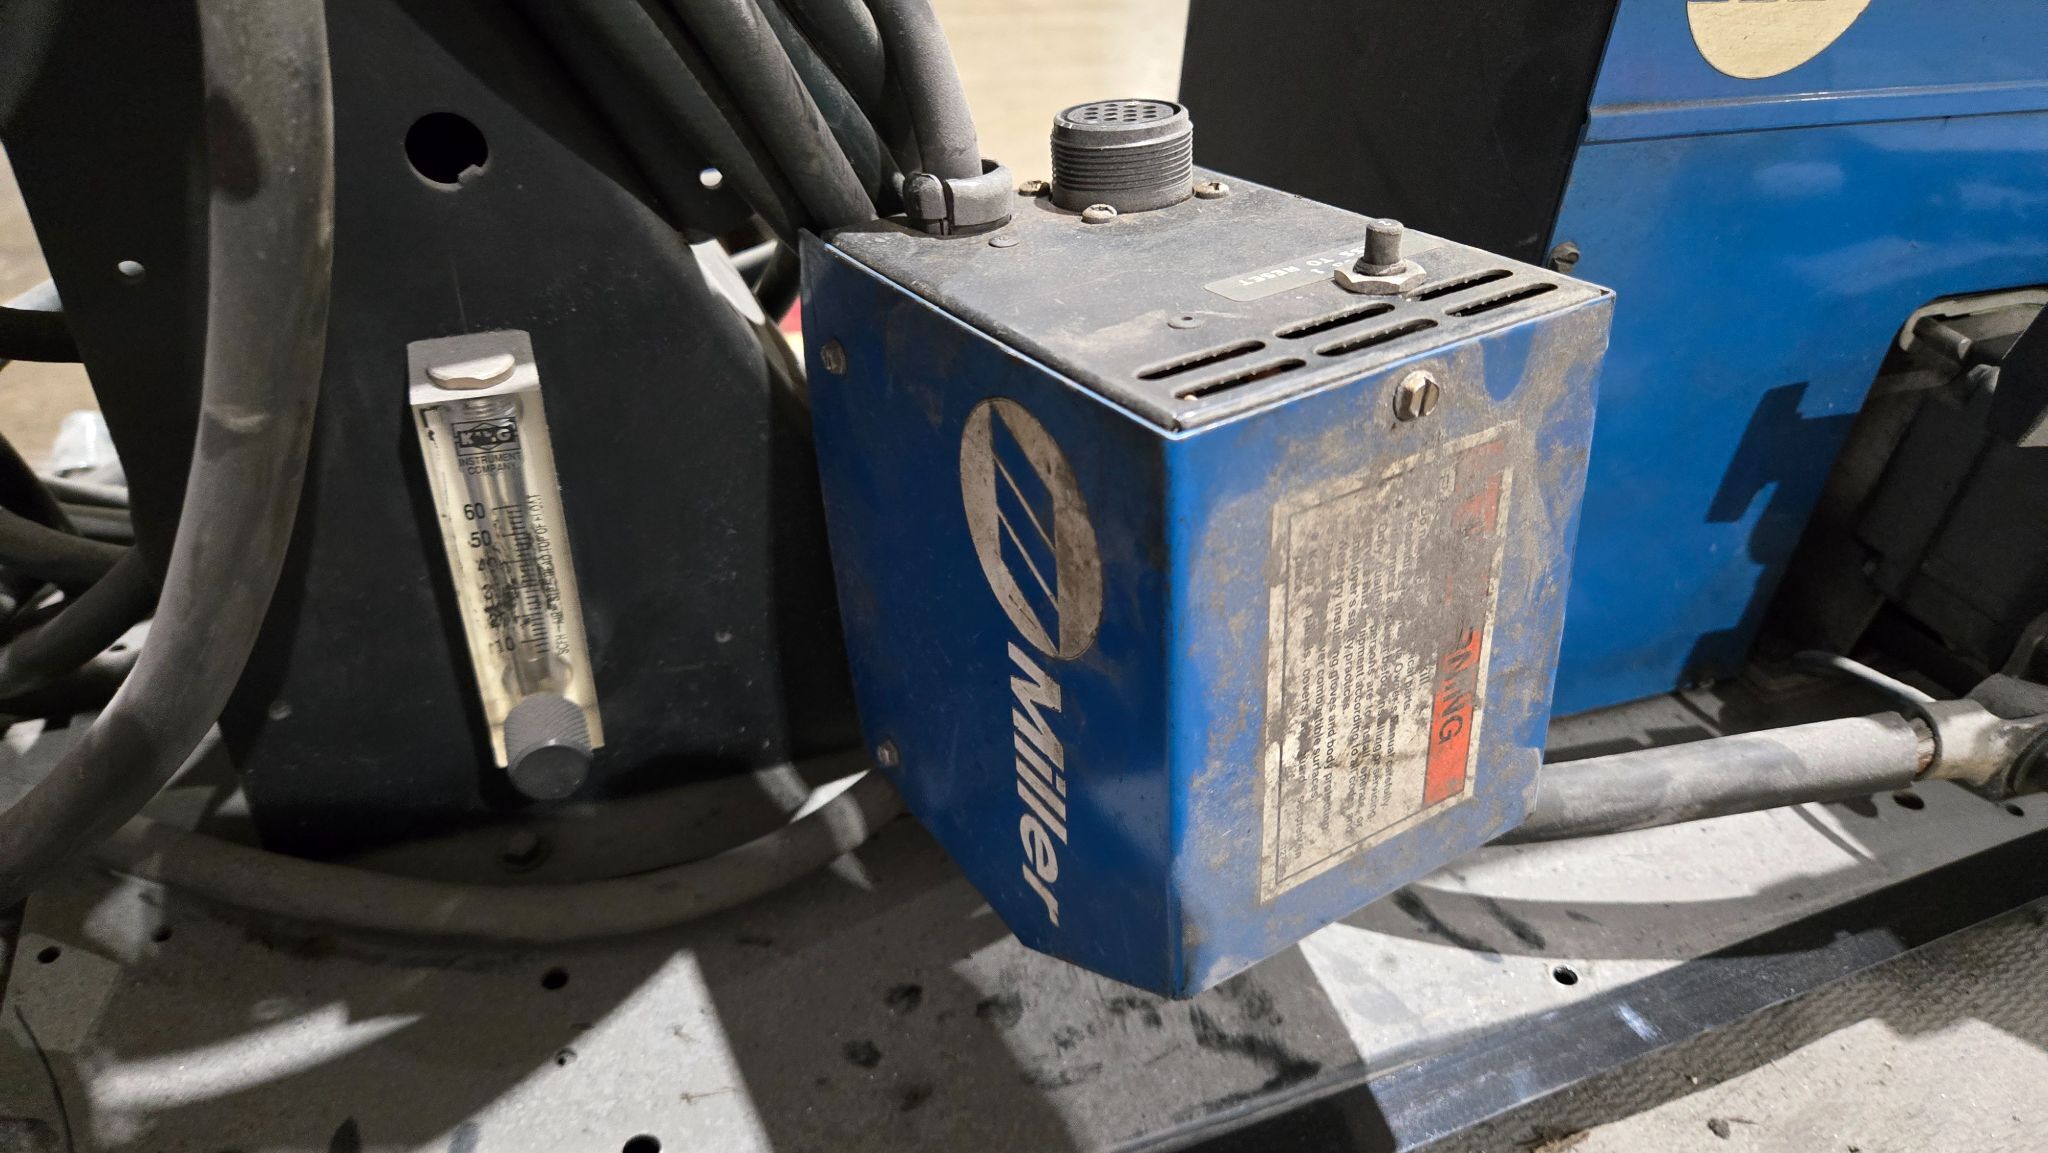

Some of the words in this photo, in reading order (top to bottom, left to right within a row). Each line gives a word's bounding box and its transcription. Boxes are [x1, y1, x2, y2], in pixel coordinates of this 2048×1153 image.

[1238, 265, 1300, 286] RESET
[458, 451, 522, 467] INSTRUMENT
[467, 462, 516, 475] COMPANY
[464, 502, 485, 520] 60
[470, 530, 492, 548] 50
[1332, 575, 1345, 601] dry
[1344, 608, 1357, 652] safty
[1353, 607, 1369, 679] uipment
[1365, 622, 1378, 677] persons
[1378, 653, 1390, 696] befo
[1325, 668, 1340, 714] gloves
[1365, 678, 1375, 700] are
[1399, 679, 1414, 717] parts.
[1312, 666, 1327, 747] combustible
[1364, 703, 1373, 719] to
[1327, 712, 1337, 737] and
[1323, 738, 1336, 772] body
[1350, 742, 1360, 757] to
[1008, 640, 1068, 927] Miller
